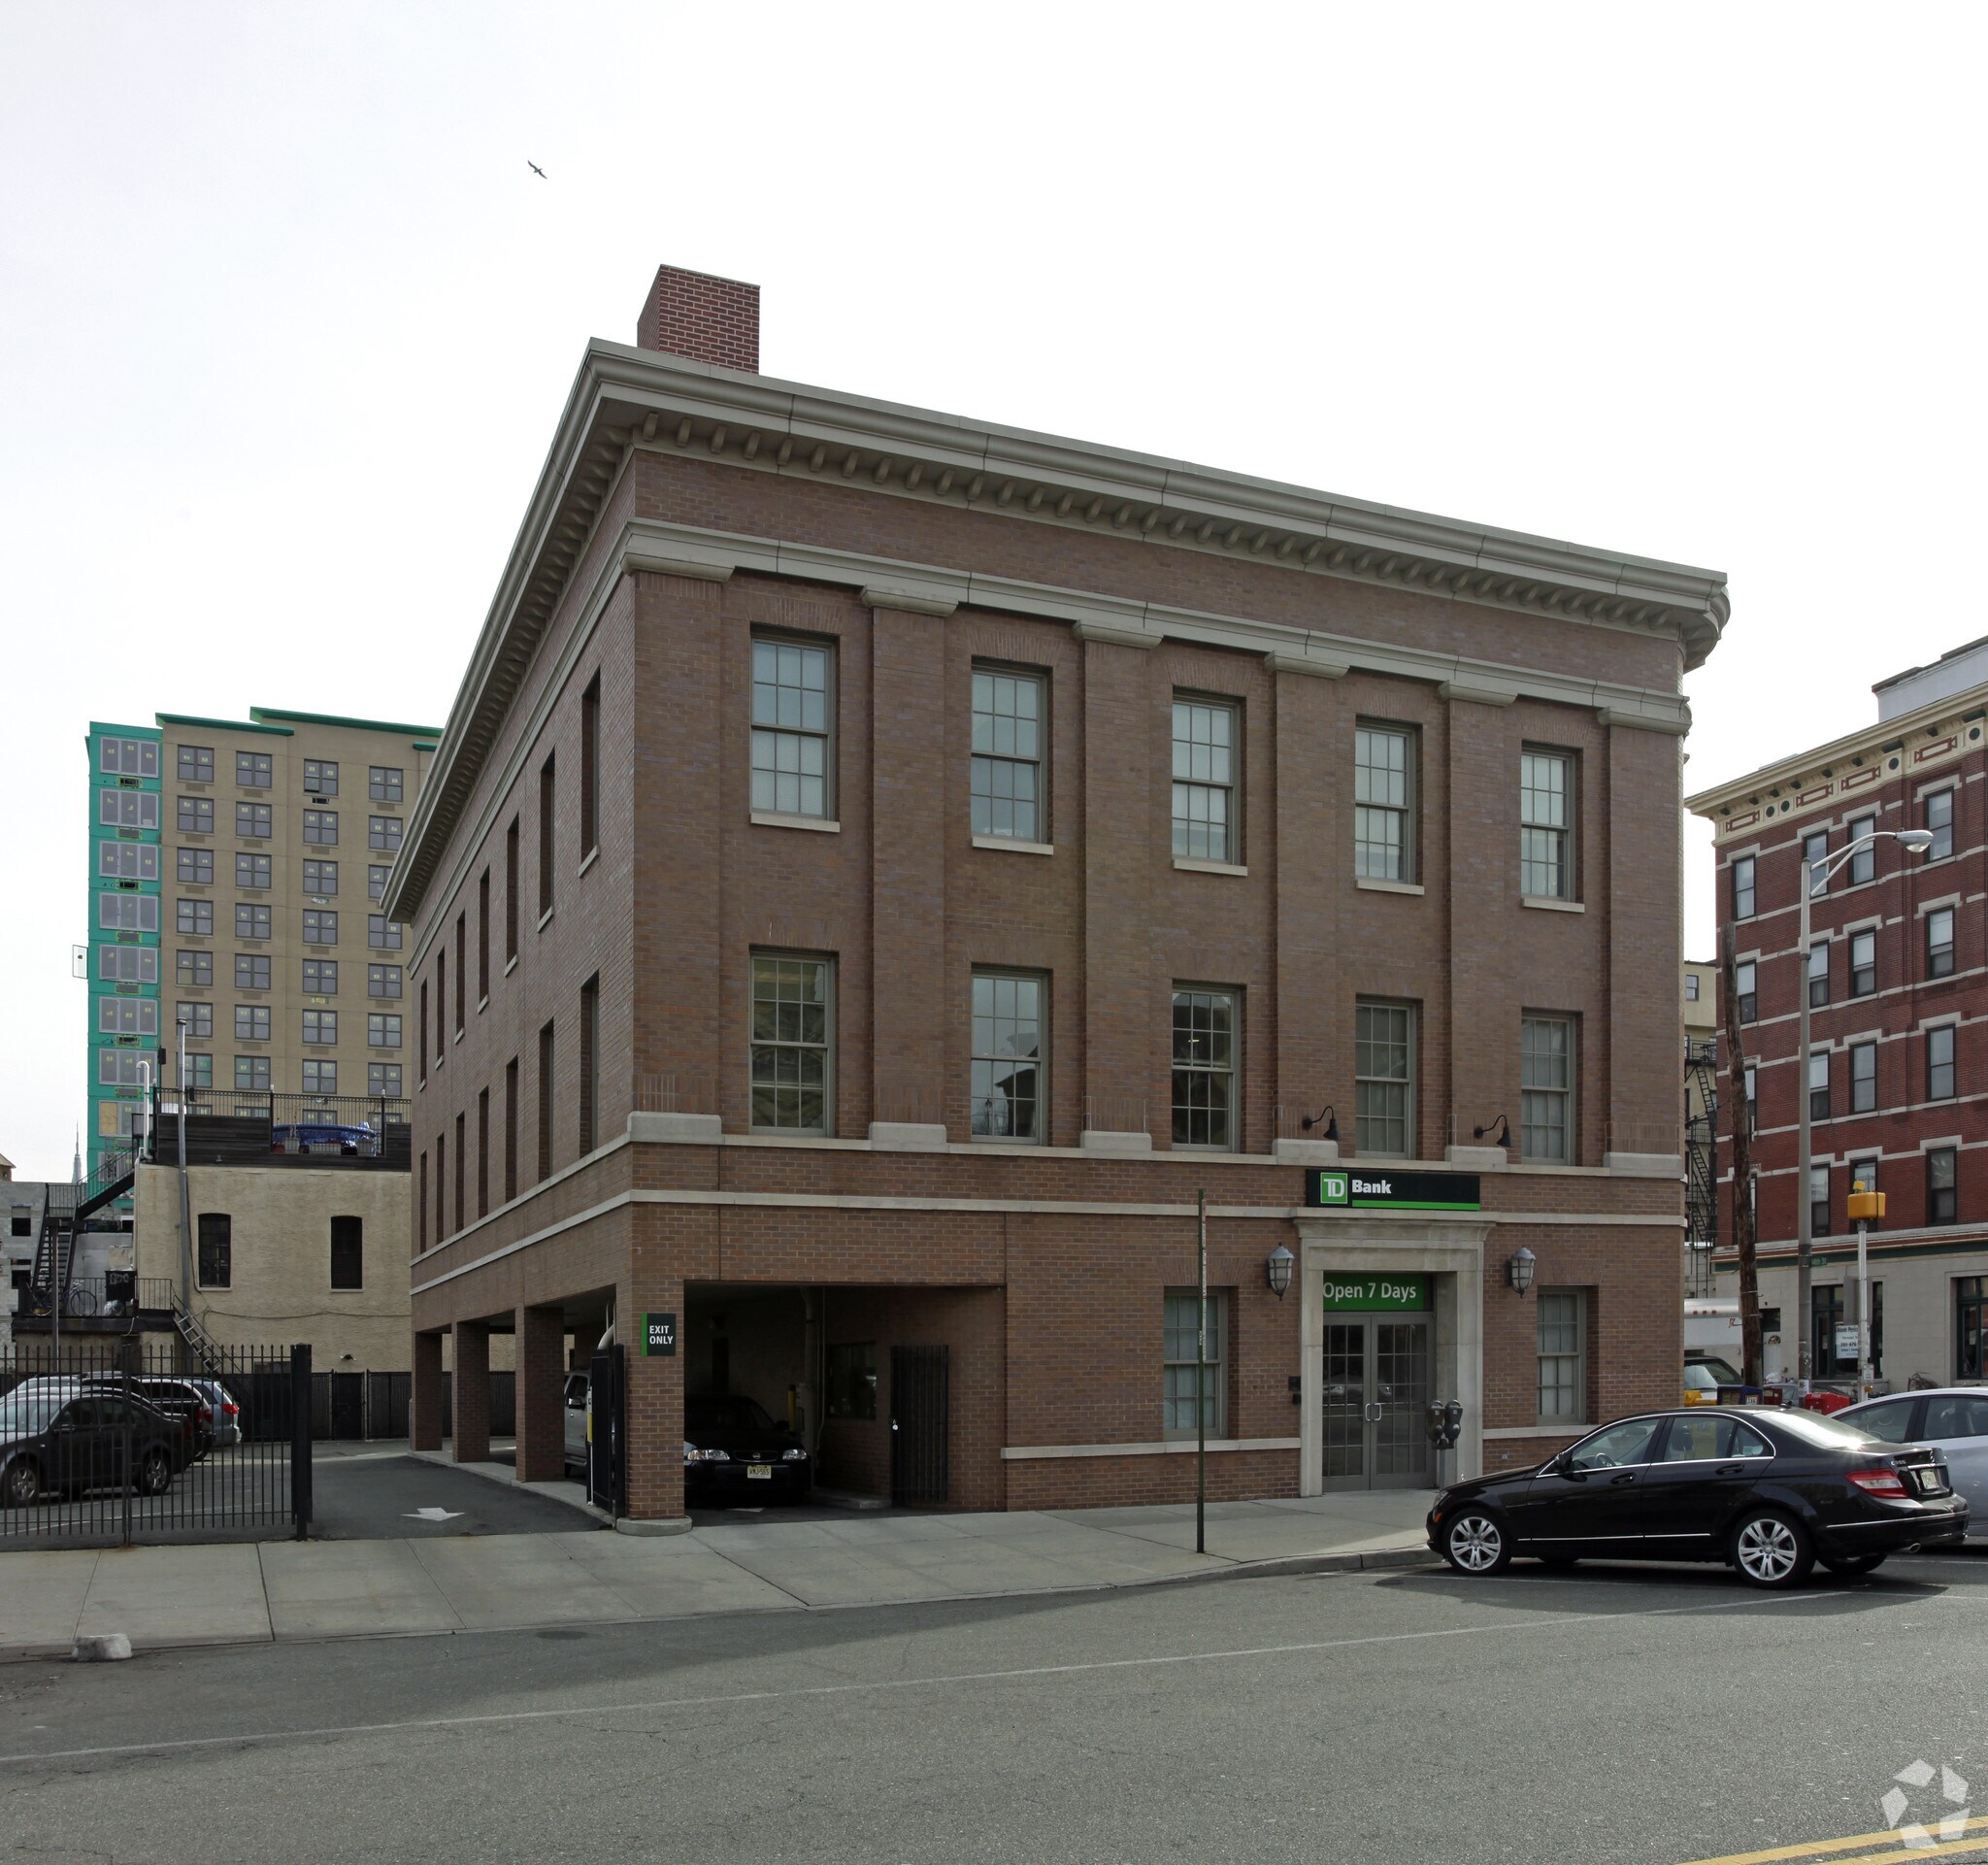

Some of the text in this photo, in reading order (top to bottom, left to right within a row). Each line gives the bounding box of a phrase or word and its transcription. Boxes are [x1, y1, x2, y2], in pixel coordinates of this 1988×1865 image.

[1324, 1179, 1392, 1197] TD Bank
[1323, 1282, 1417, 1303] Open 7 Days
[648, 1325, 670, 1334] EXIT
[648, 1335, 674, 1345] ONLY
